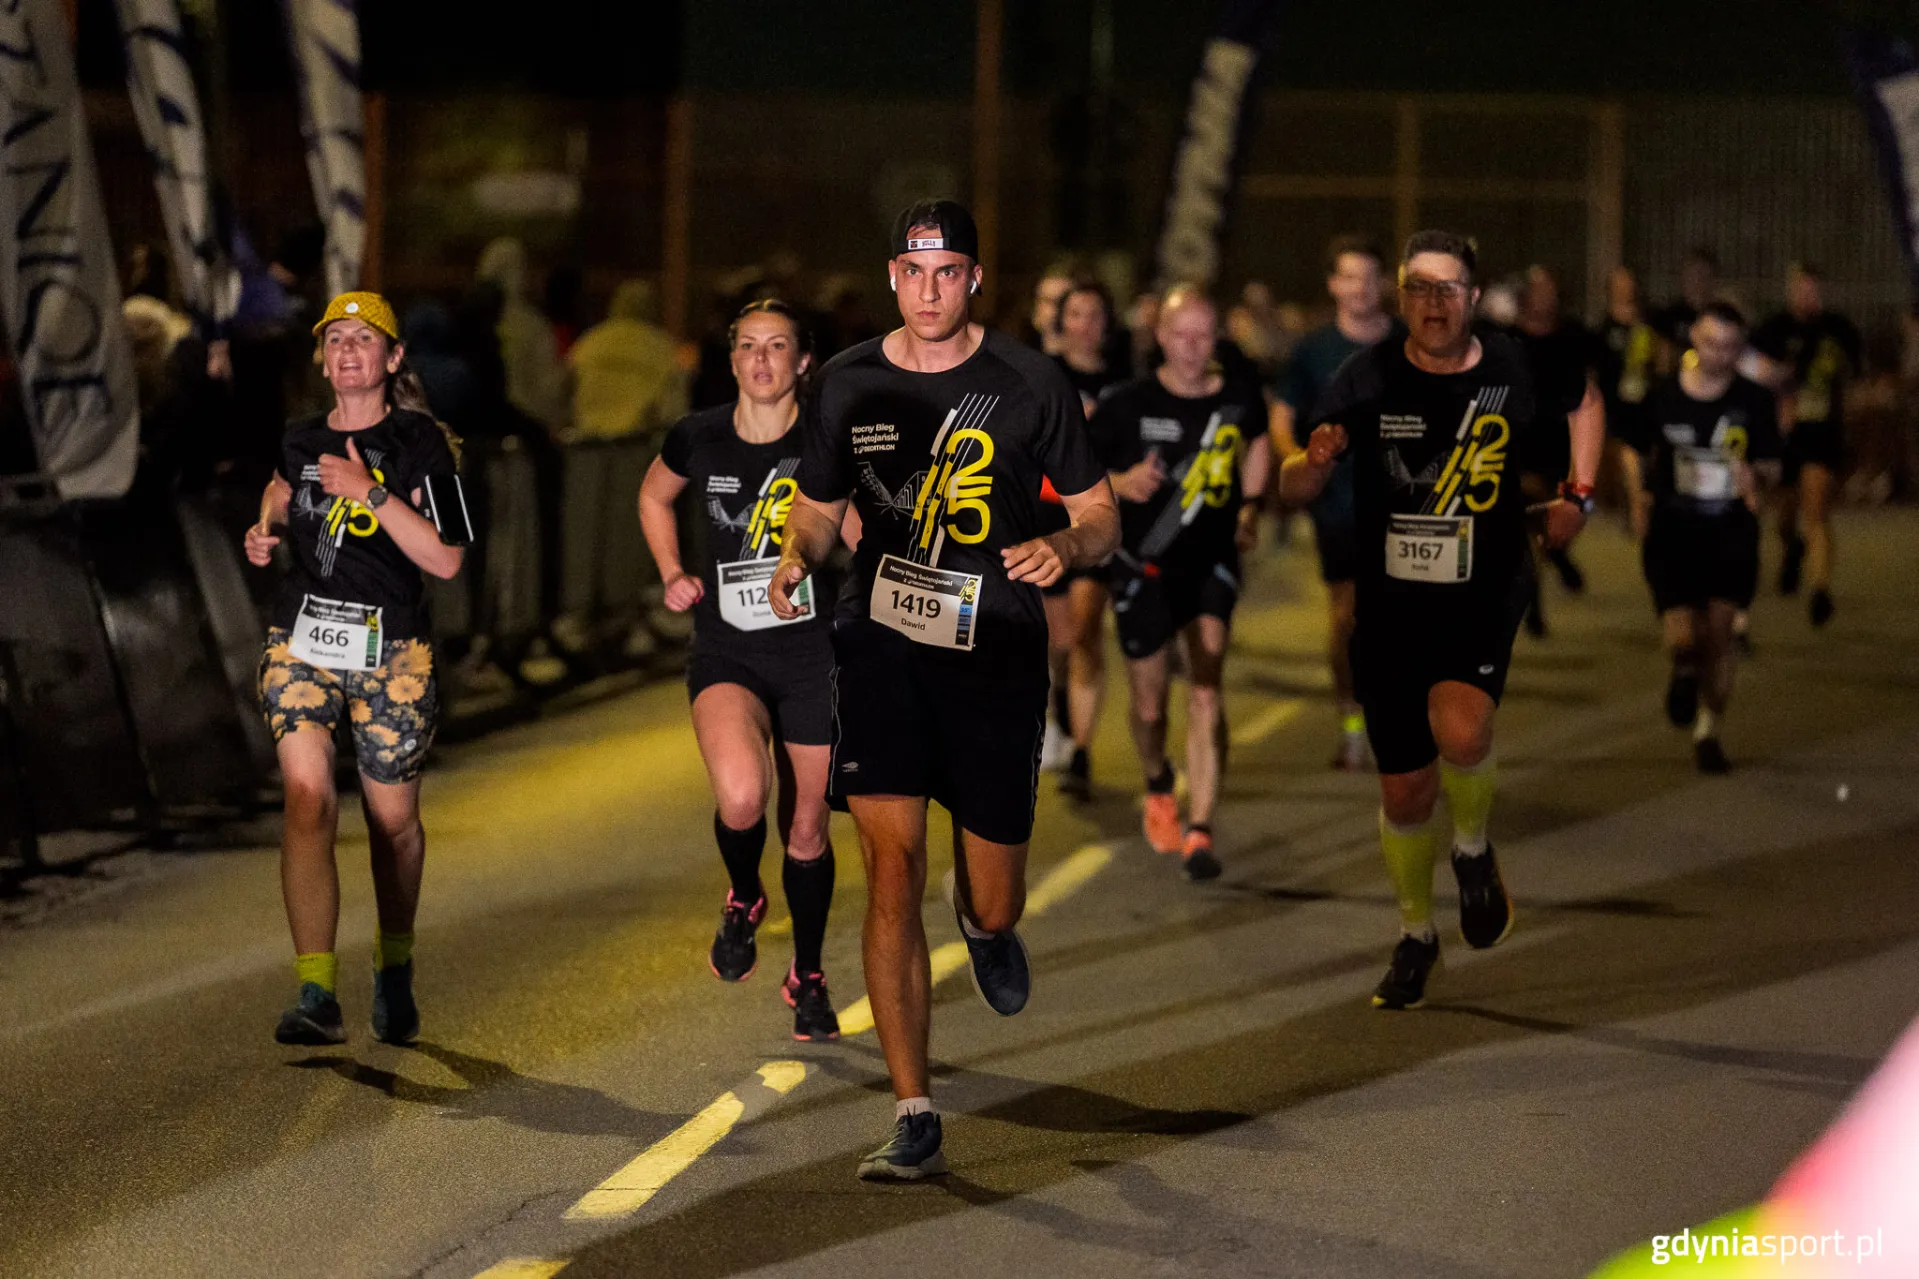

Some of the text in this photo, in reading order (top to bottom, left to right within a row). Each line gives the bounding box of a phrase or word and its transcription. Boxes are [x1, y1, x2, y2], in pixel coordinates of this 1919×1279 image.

[852, 423, 895, 434] Nocny Bieg
[852, 432, 899, 445] Świętojański
[1398, 541, 1444, 560] 3167
[890, 565, 905, 575] Nocny
[906, 570, 917, 579] Bieg
[737, 586, 769, 607] 112
[891, 589, 942, 619] 1419
[901, 618, 926, 631] Dawid
[309, 626, 349, 647] 466
